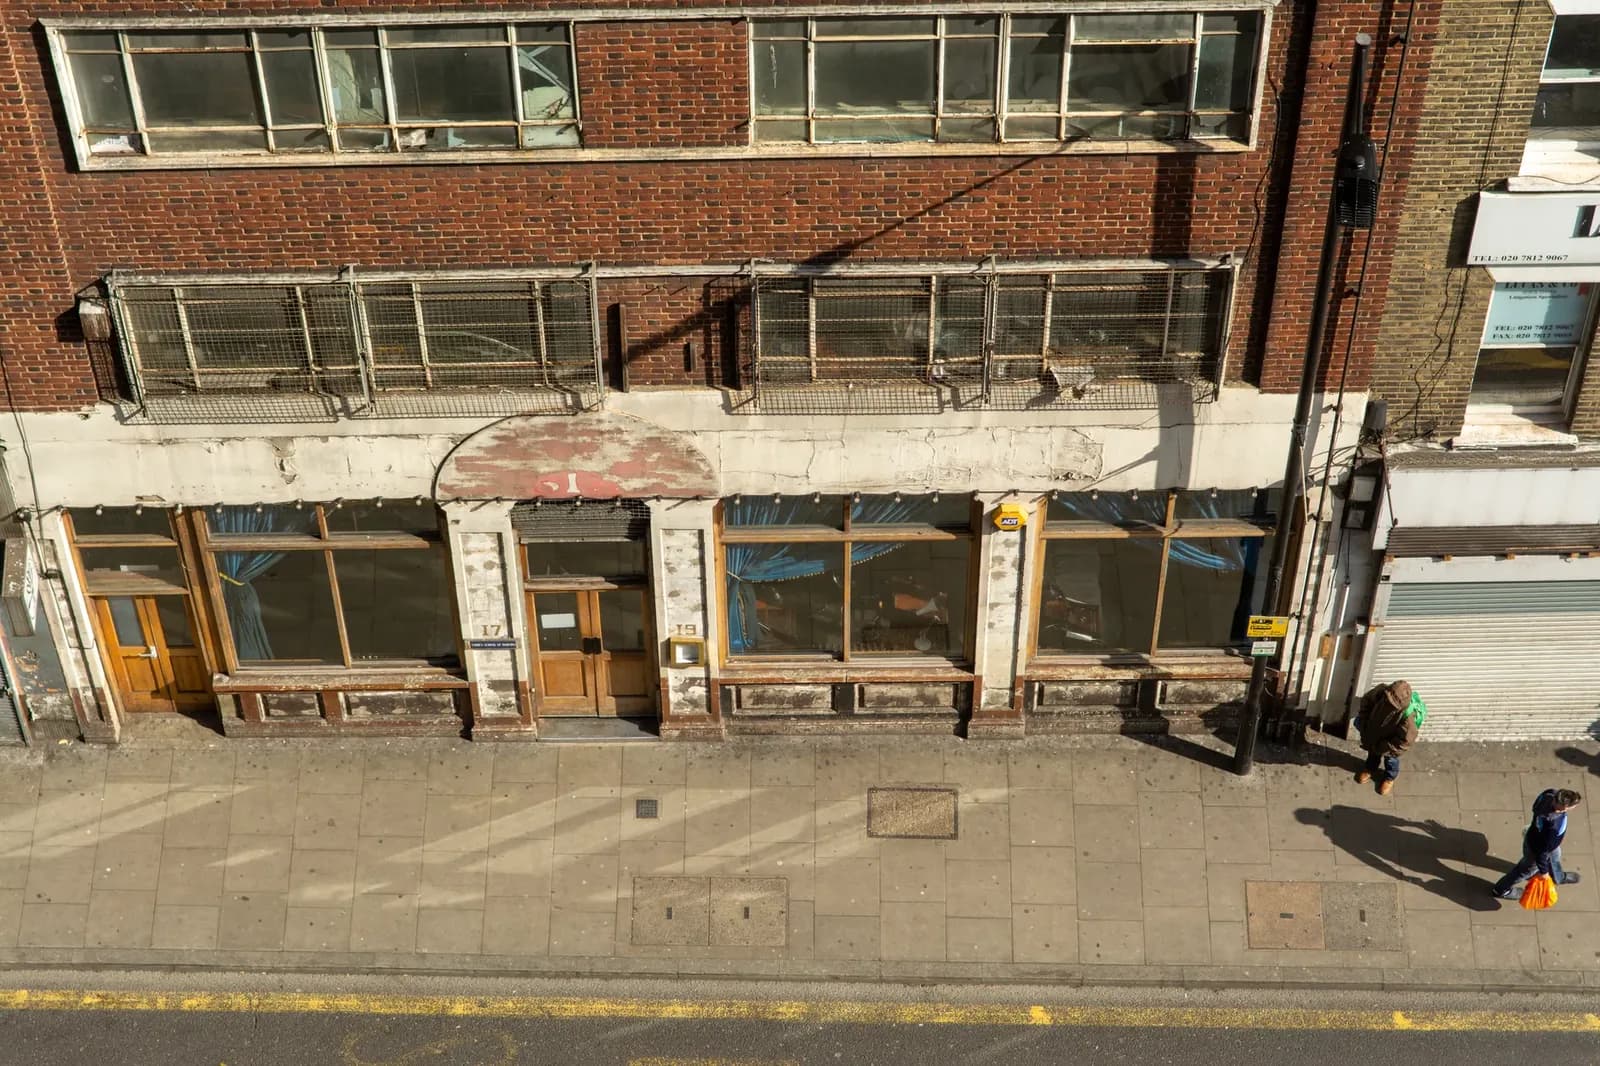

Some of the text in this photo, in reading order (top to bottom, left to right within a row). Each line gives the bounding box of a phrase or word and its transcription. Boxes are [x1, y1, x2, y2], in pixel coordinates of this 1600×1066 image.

[1521, 254, 1543, 262] 7812
[481, 625, 501, 636] 17
[676, 624, 696, 635] 19
